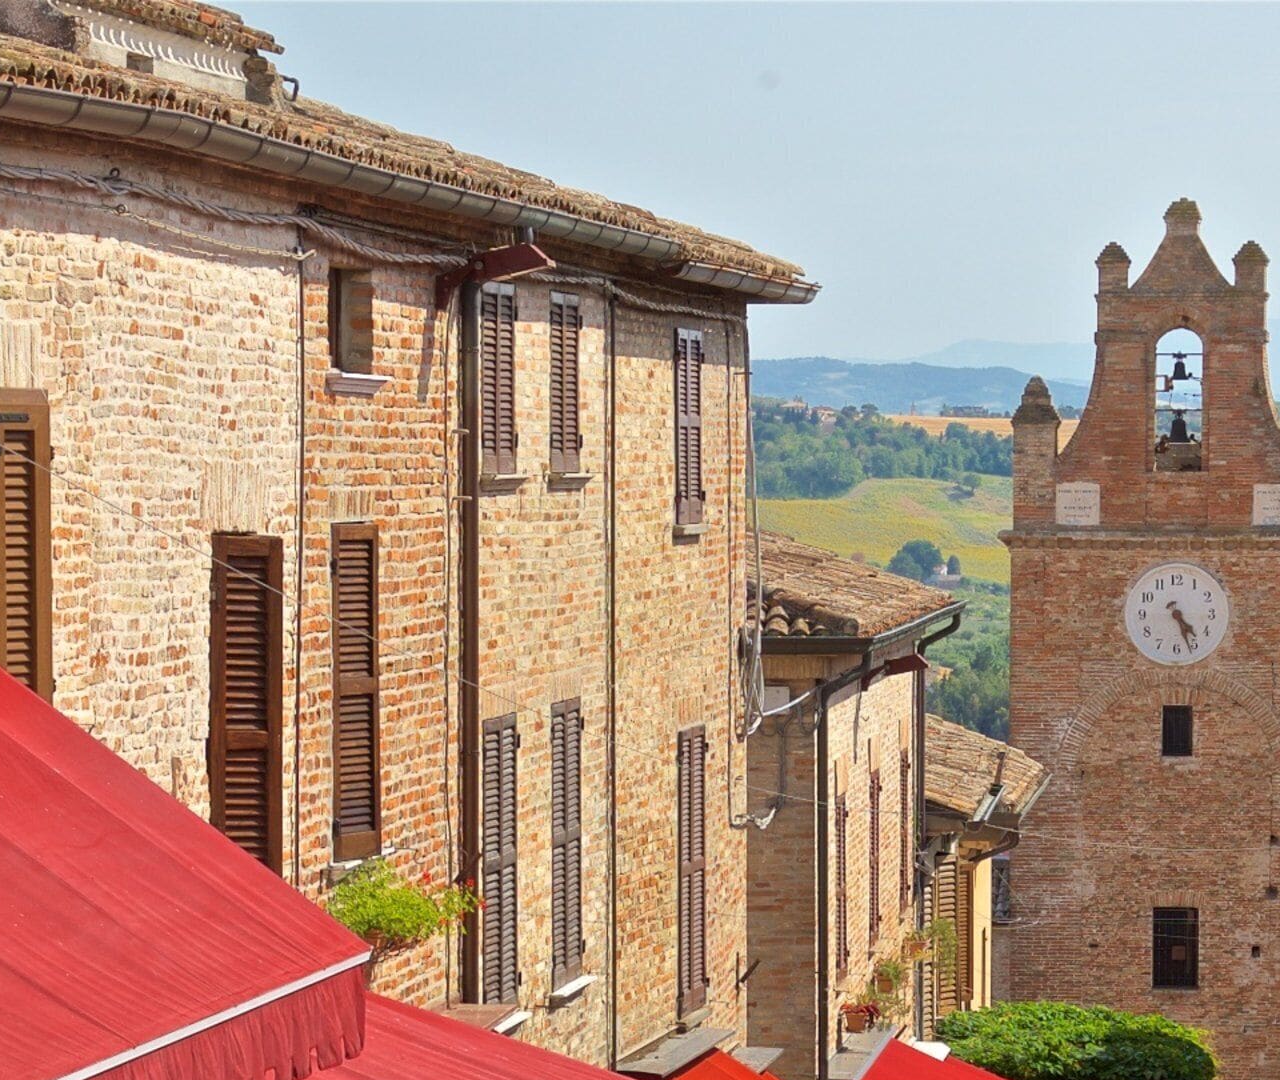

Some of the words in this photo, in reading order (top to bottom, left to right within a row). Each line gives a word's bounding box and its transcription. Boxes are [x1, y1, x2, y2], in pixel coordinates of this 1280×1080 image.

[1155, 579, 1164, 590] 11
[1170, 574, 1184, 586] 12
[1191, 579, 1197, 590] 1
[1141, 592, 1154, 603] 10
[1203, 592, 1212, 603] 2
[1138, 609, 1147, 620] 9
[1208, 609, 1216, 620] 3
[1143, 626, 1151, 638] 8
[1202, 626, 1209, 637] 4
[1156, 639, 1163, 650] 7
[1172, 644, 1181, 655] 6
[1191, 639, 1199, 650] 5
